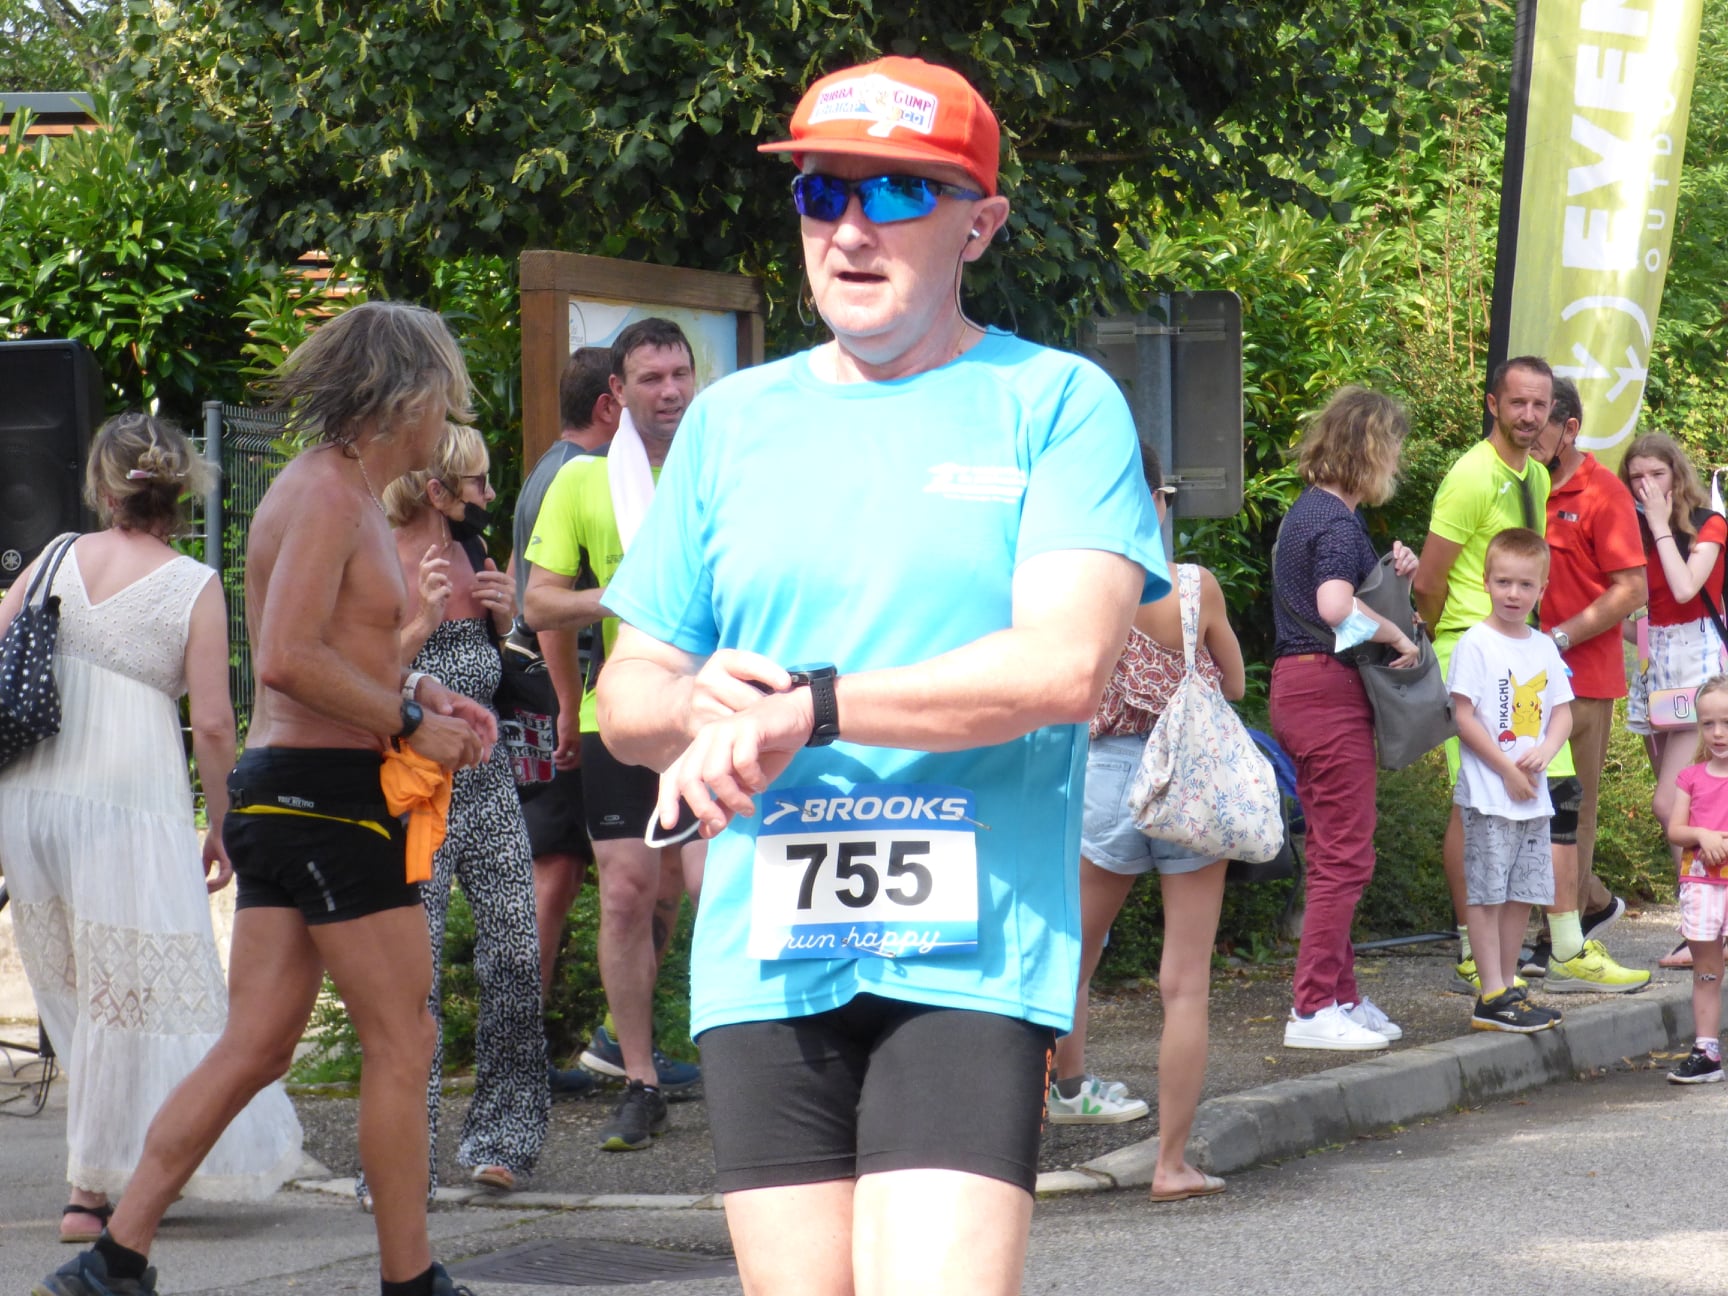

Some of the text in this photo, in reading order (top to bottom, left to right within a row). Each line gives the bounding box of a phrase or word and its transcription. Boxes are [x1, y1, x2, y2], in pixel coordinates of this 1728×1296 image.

[893, 89, 932, 112] GUMP
[1498, 678, 1509, 729] PIKACHU
[801, 796, 968, 823] BROOKS
[786, 840, 933, 910] 755
[786, 926, 941, 954] run happy
